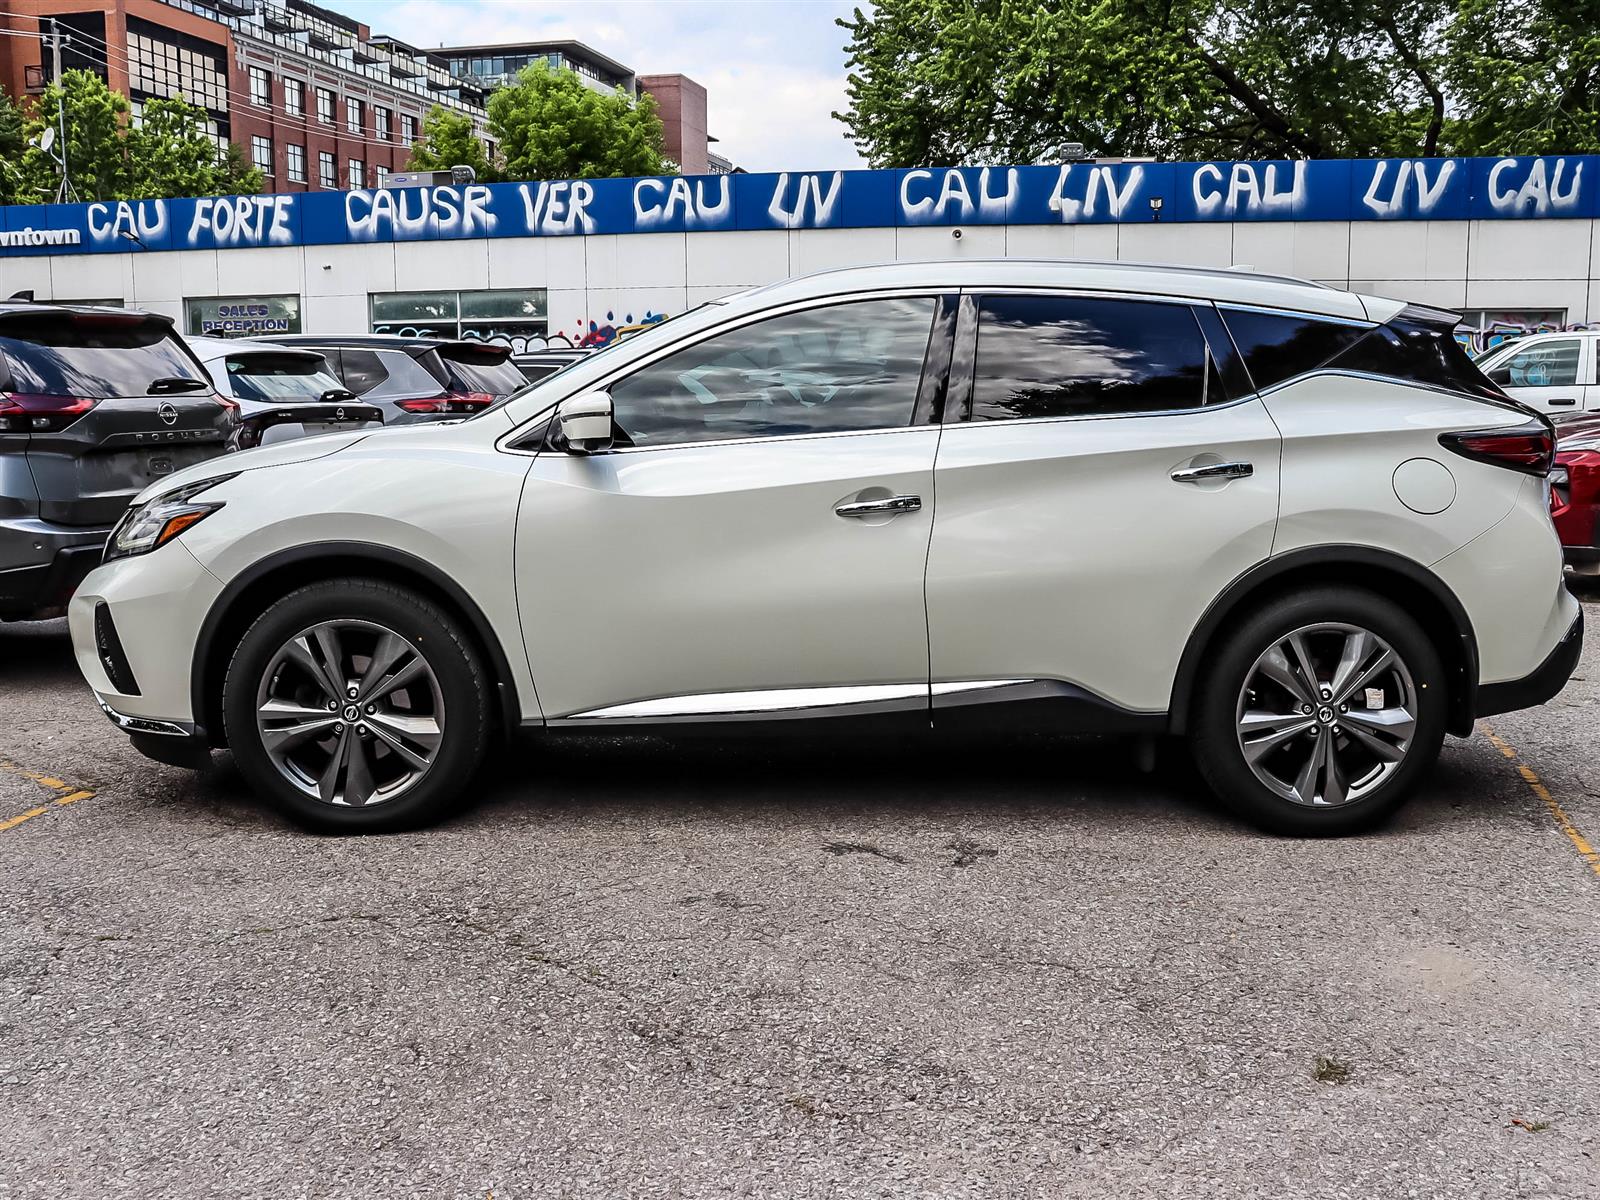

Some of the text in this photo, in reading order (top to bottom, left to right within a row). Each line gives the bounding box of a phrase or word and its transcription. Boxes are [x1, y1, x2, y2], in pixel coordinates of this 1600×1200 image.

[87, 199, 170, 241] CAU
[187, 196, 294, 244] FORTE
[519, 180, 597, 235] VER
[633, 175, 730, 226] CAU
[1048, 164, 1143, 222] LIV
[1363, 160, 1456, 217] LIV
[1488, 158, 1583, 215] CAU
[218, 304, 269, 318] SALES
[202, 318, 288, 332] RECEPTION
[135, 431, 201, 441] ROGUE
